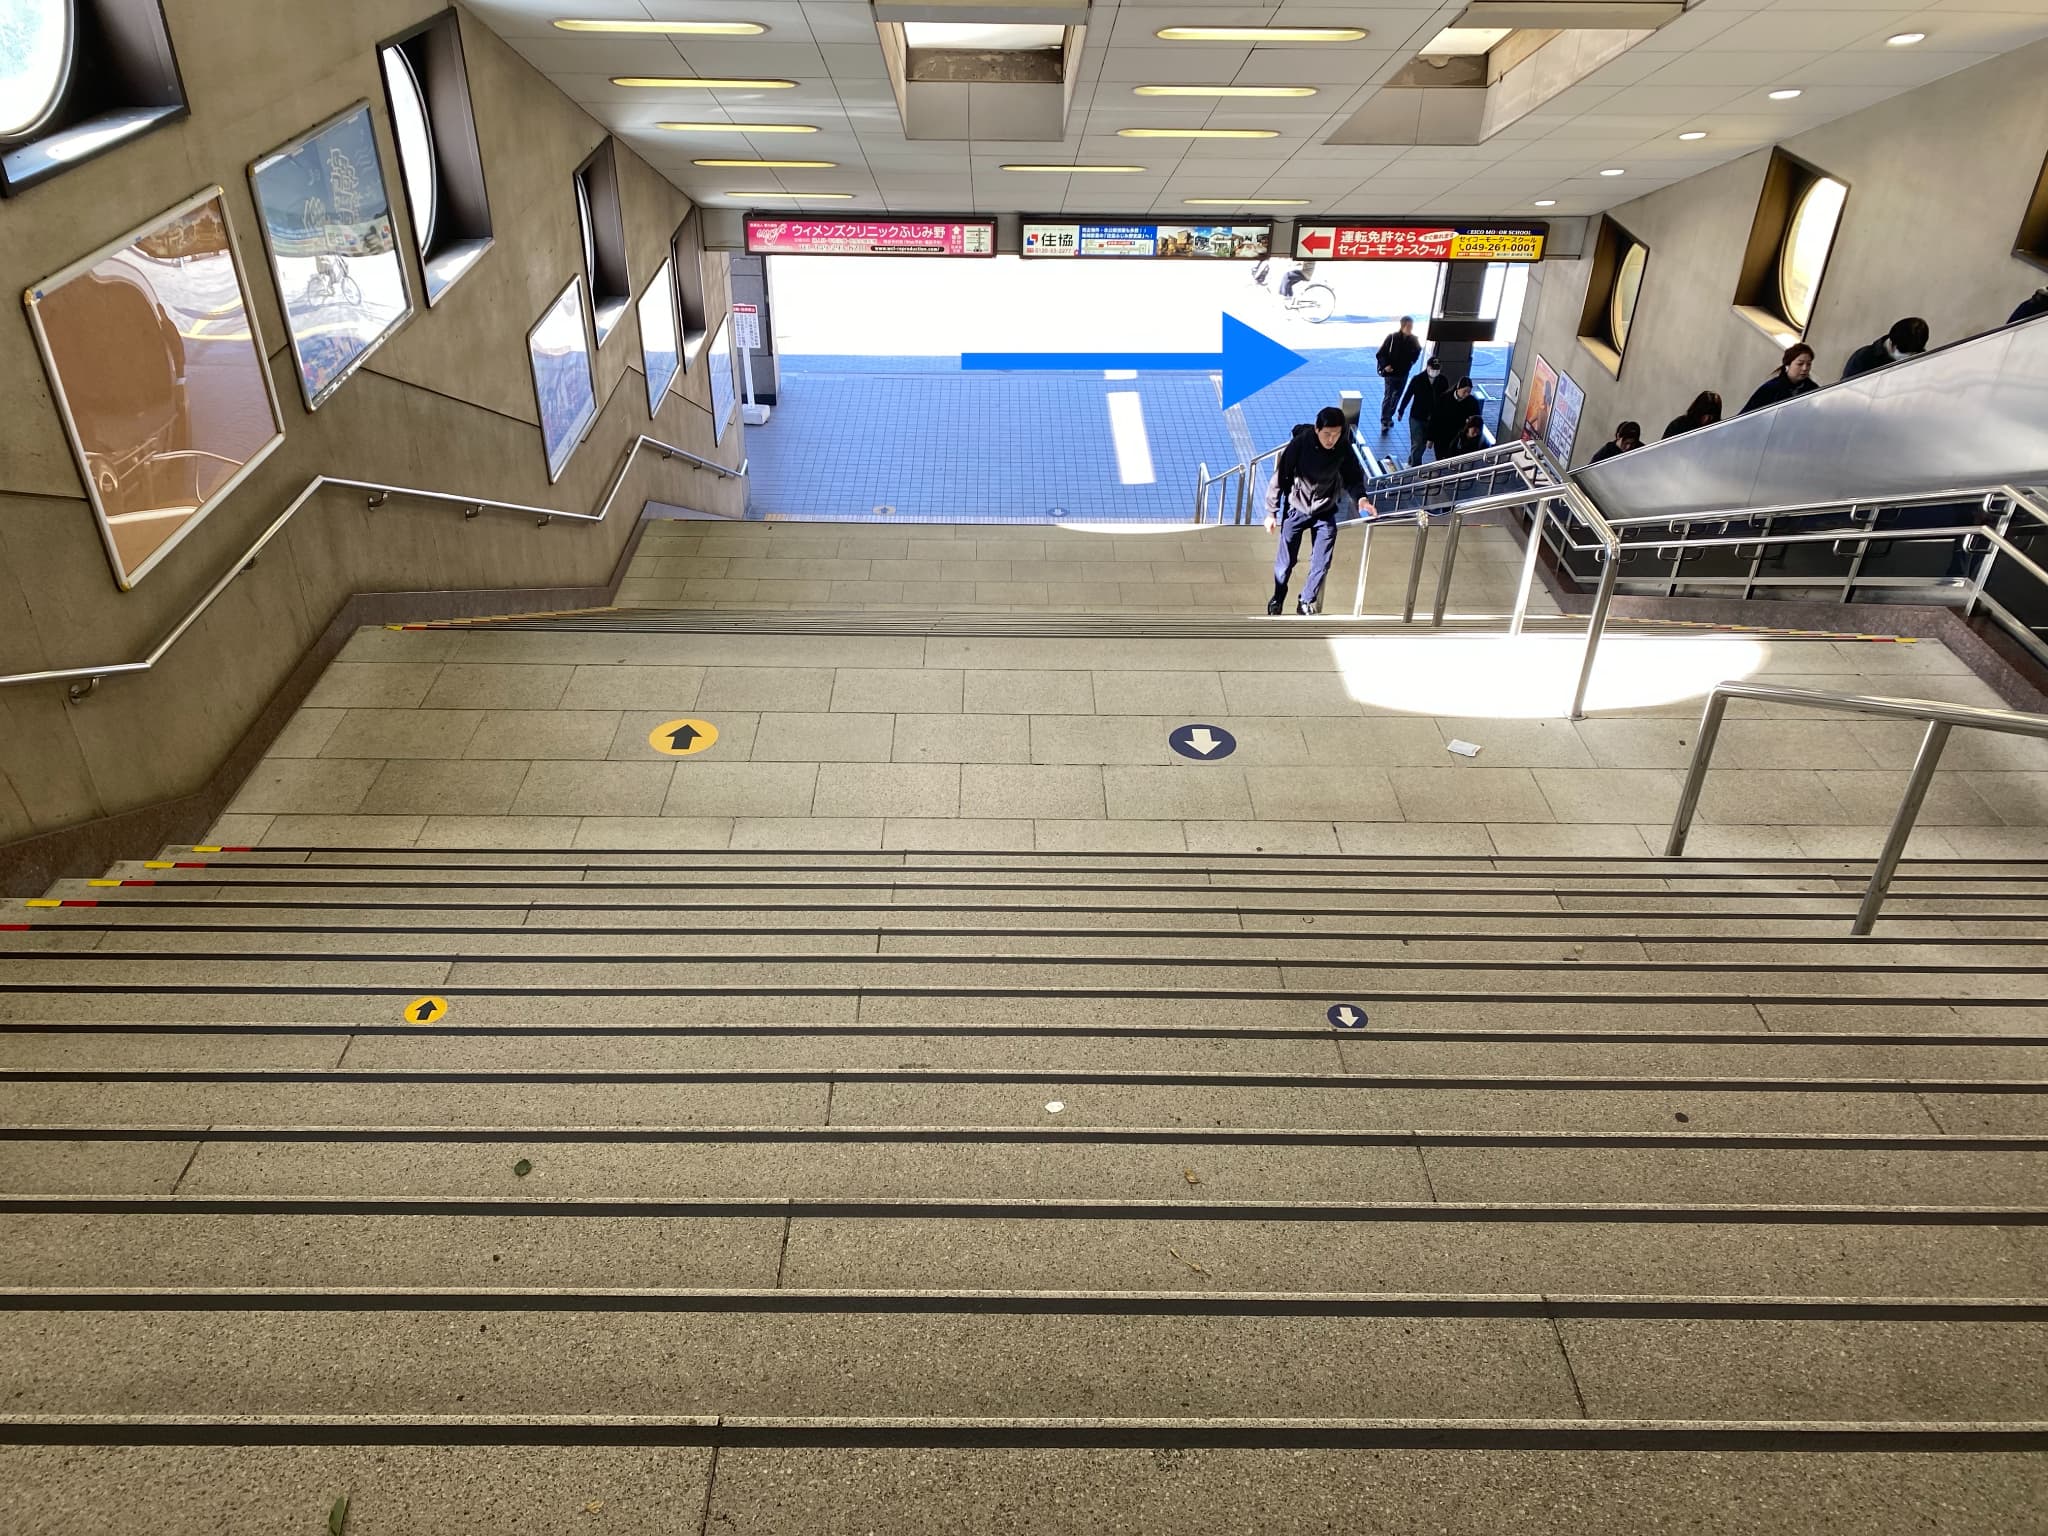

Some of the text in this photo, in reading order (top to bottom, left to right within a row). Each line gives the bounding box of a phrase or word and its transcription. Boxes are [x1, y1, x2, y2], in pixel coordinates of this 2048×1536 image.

[791, 224, 946, 239] ウィメンズクリニックふじみ野
[1340, 230, 1417, 243] 運転免許なら
[1041, 233, 1074, 247] 住協
[1459, 236, 1537, 244] セイコーモータースクール
[1338, 243, 1447, 256] セイコーモータースクール
[1465, 243, 1535, 252] 049-261-0001
